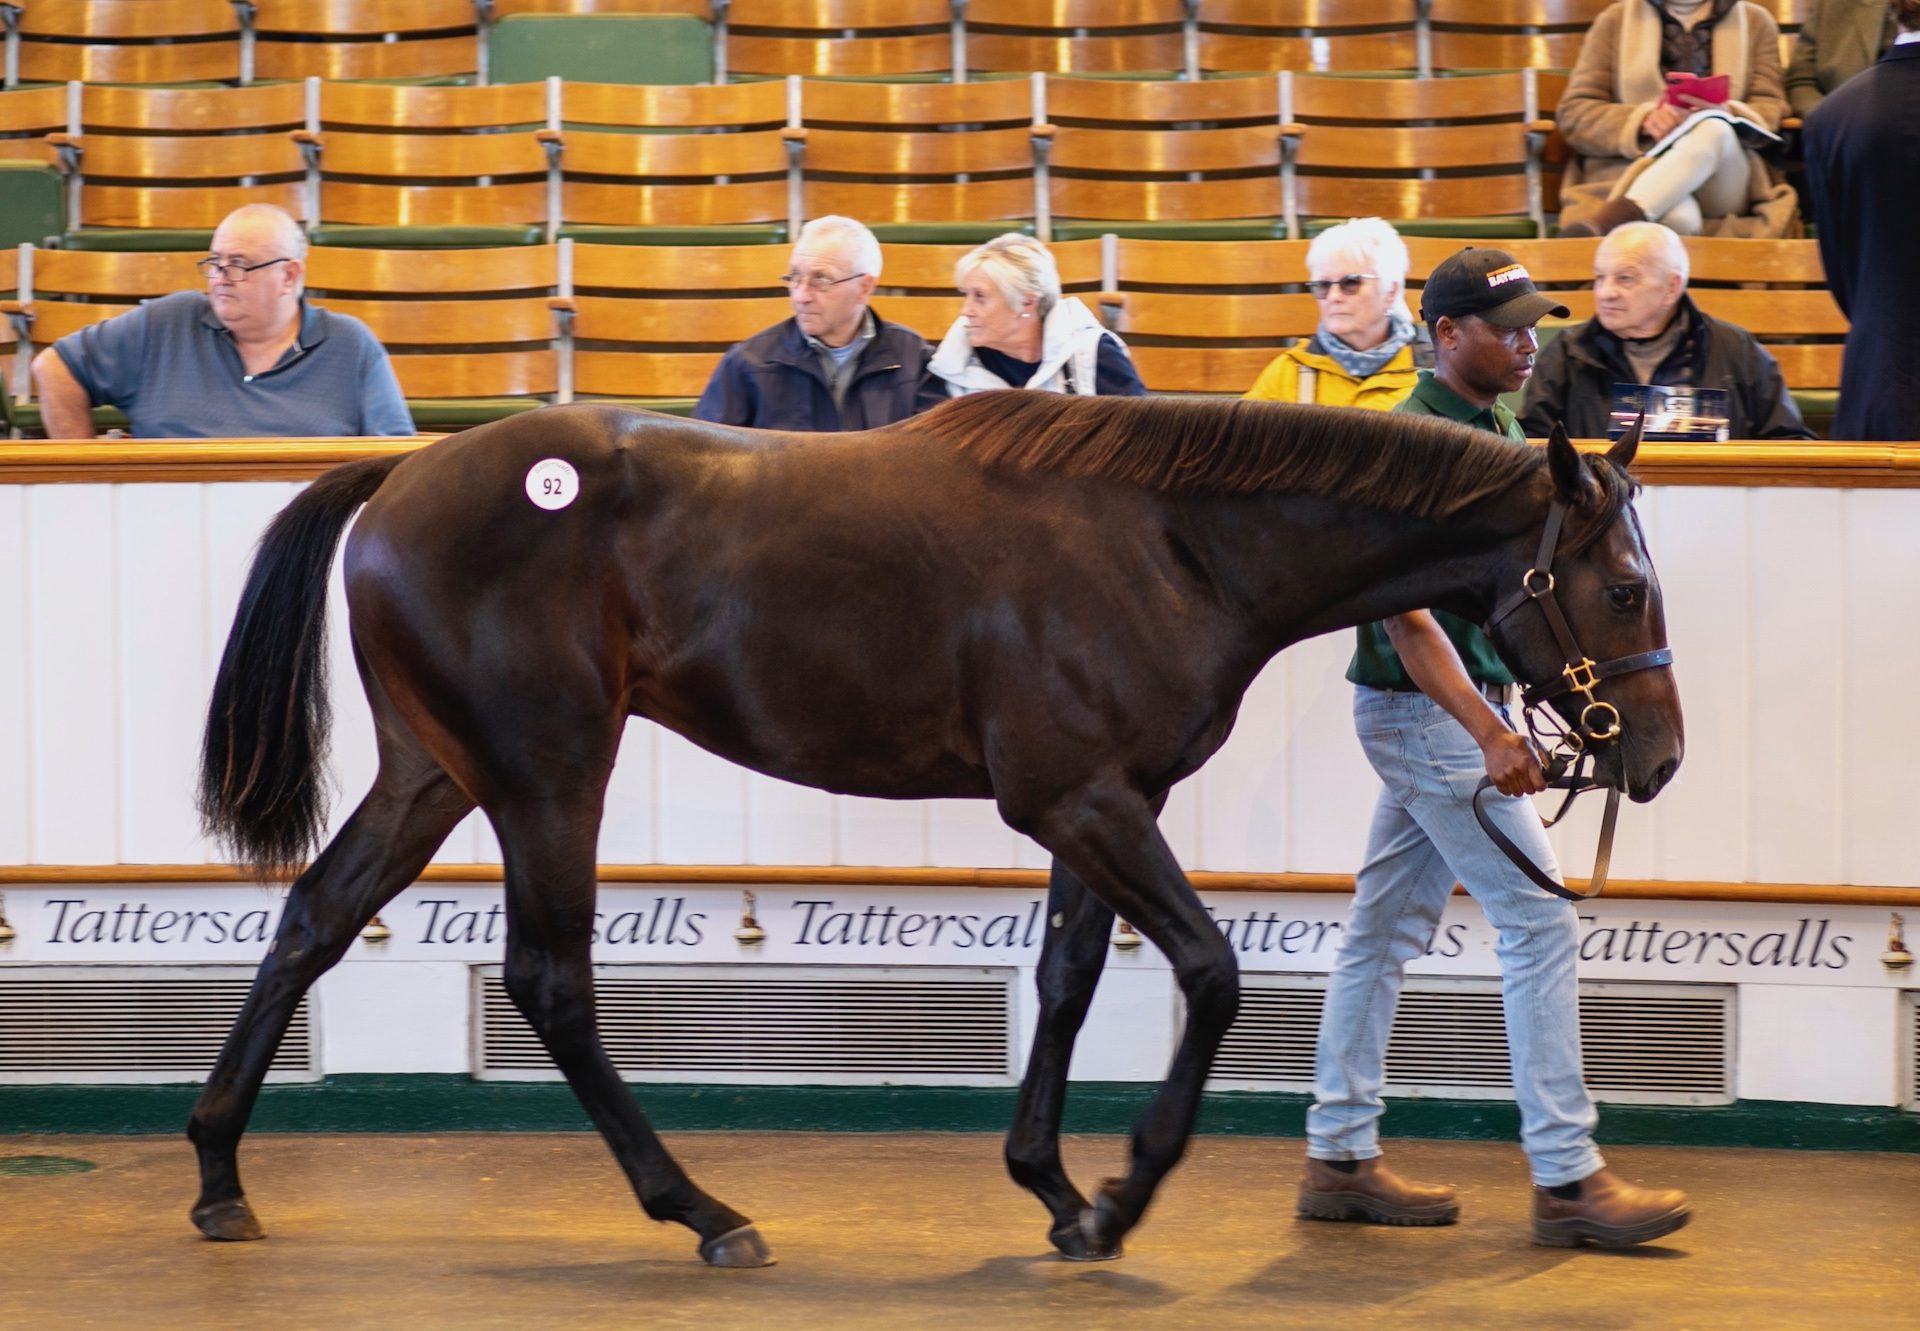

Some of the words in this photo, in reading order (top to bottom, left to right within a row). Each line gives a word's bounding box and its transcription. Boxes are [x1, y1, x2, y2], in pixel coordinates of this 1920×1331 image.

[543, 478, 562, 495] 92
[45, 897, 288, 944] Tattersa
[417, 897, 709, 946] Tatalls
[791, 899, 1043, 949] Tattersal
